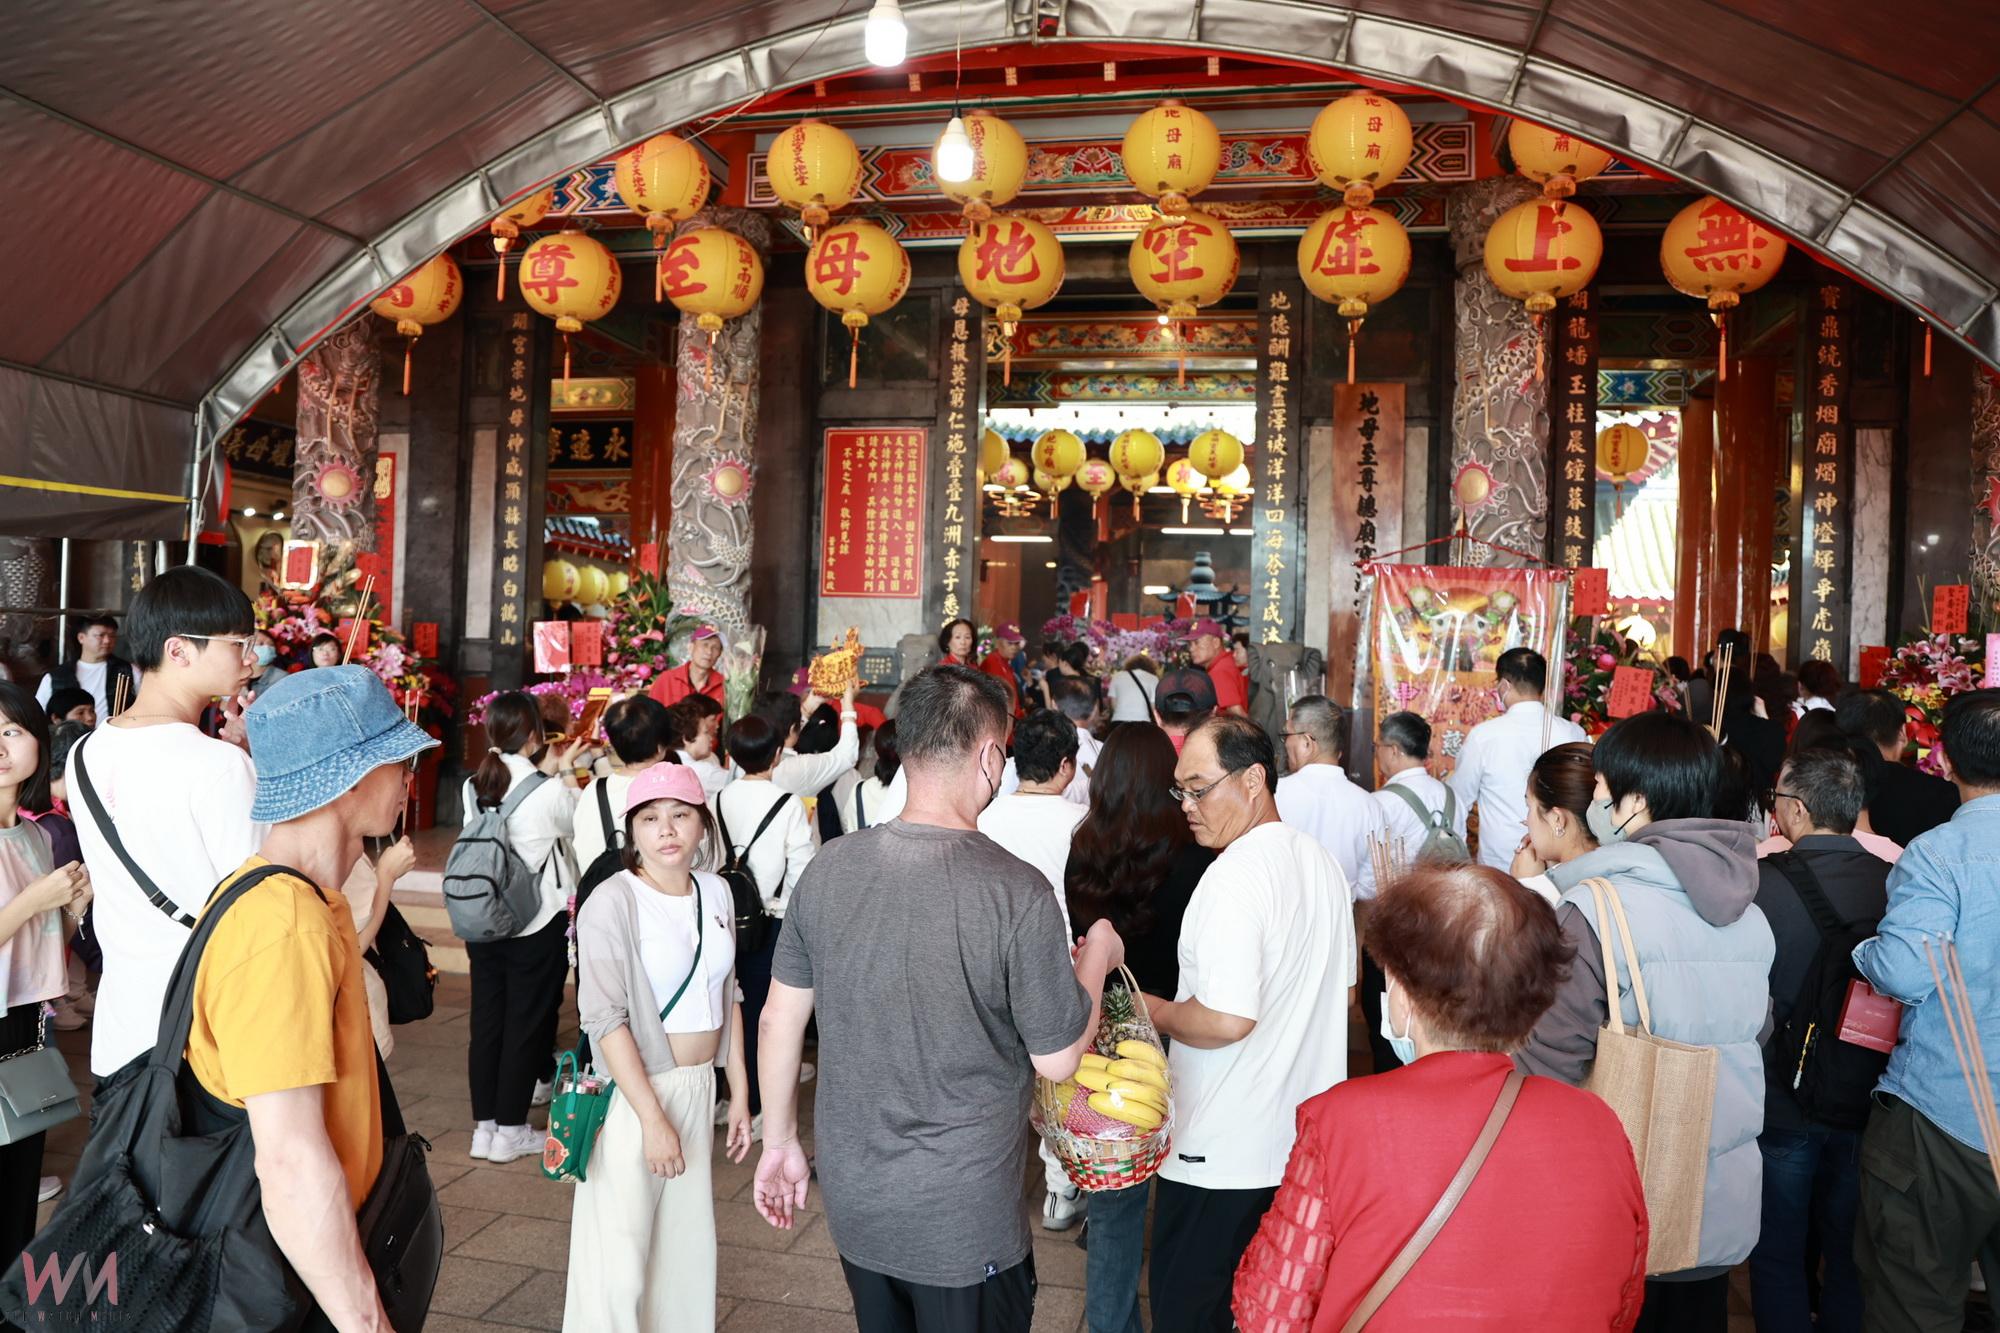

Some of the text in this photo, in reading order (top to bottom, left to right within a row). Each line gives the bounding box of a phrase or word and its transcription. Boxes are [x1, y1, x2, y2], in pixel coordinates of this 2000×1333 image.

[661, 236, 708, 299] 至
[815, 231, 870, 295] 母
[976, 221, 1040, 284] 地
[1143, 222, 1213, 284] 空
[1505, 203, 1581, 273] 上
[1684, 201, 1769, 272] 無
[523, 244, 579, 304] 尊
